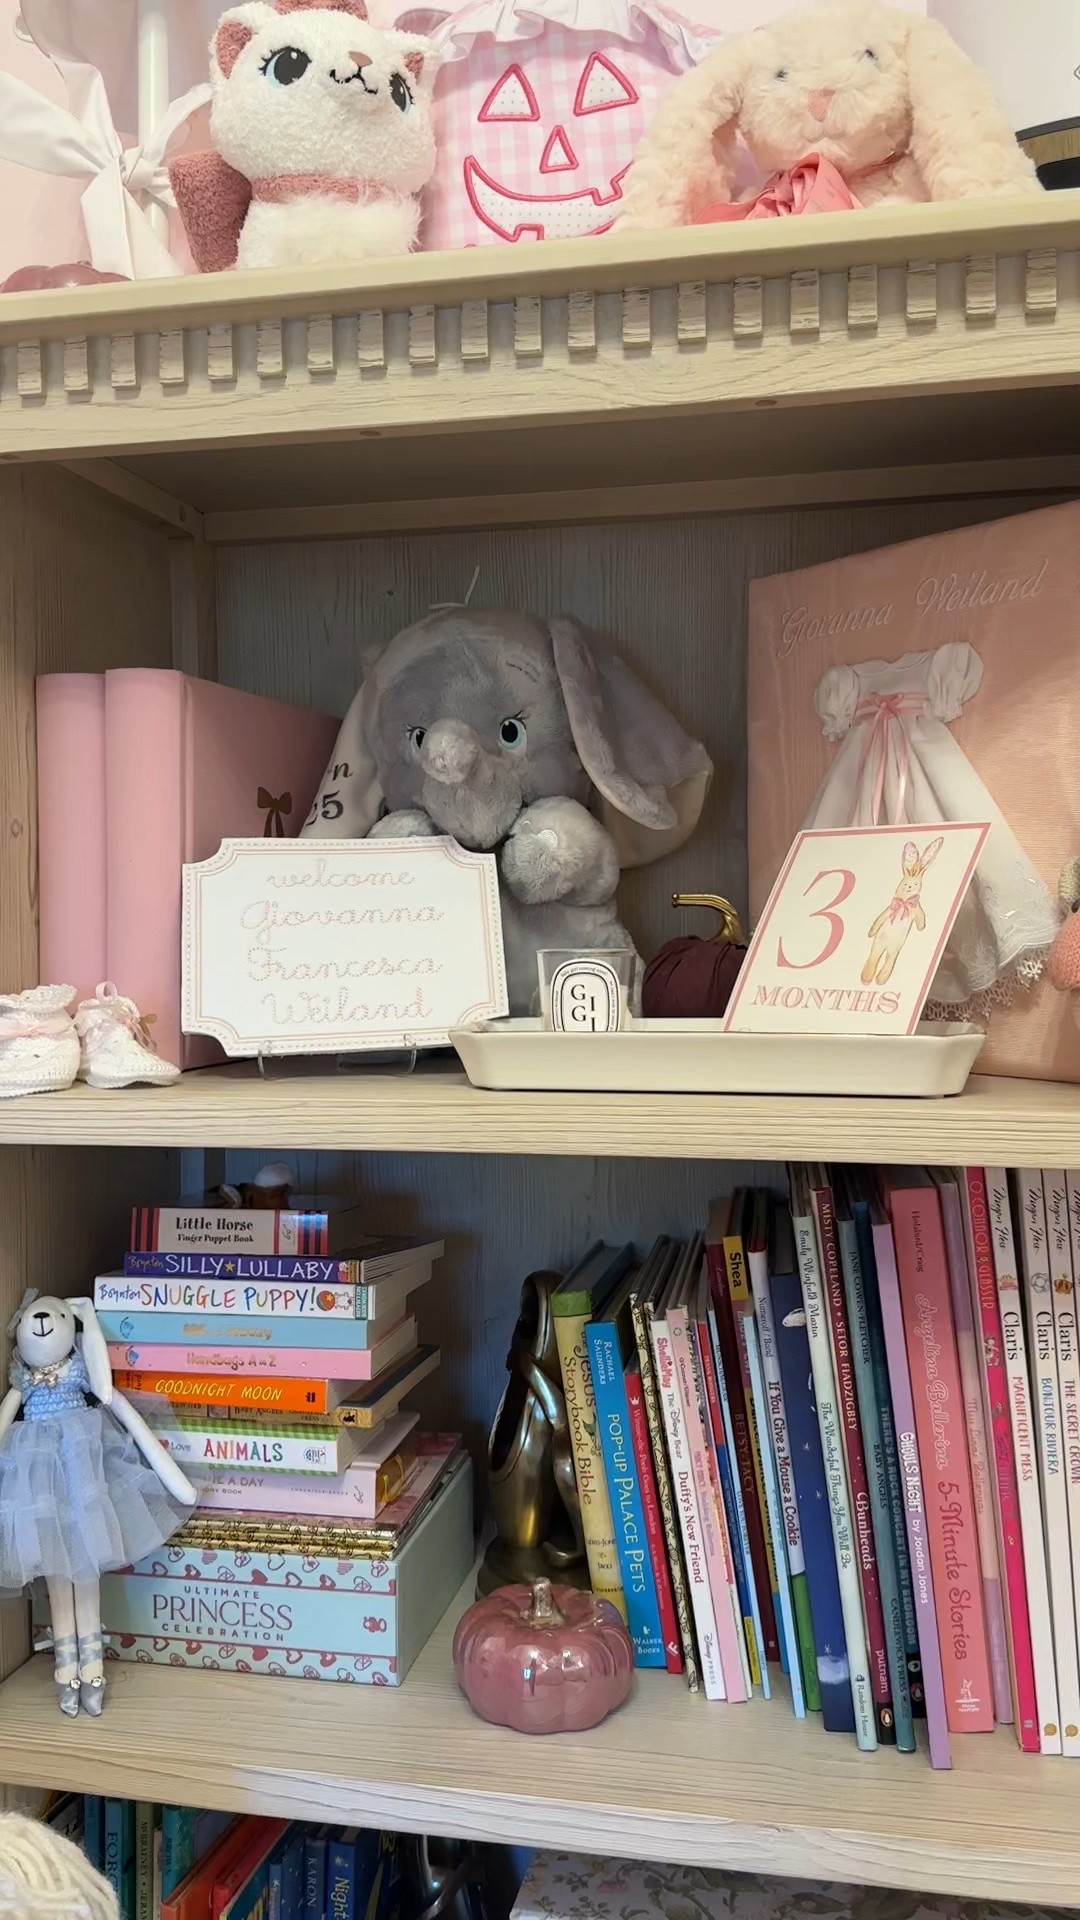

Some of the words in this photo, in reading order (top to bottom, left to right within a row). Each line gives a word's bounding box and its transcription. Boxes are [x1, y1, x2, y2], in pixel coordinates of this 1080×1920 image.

[915, 558, 1049, 617] Weiland
[267, 858, 415, 888] welcome
[240, 900, 444, 945] Giovanna
[776, 869, 857, 969] 3
[248, 947, 443, 982] Francesca
[261, 986, 433, 1024] Weiland
[752, 985, 902, 1015] MONTHS
[822, 1203, 833, 1239] MISTY
[990, 1187, 1008, 1223] Megan
[1025, 1187, 1041, 1225] Megan
[1052, 1187, 1065, 1225] Megan
[175, 1217, 213, 1231] Little
[216, 1217, 254, 1231] Horse
[177, 1234, 203, 1244] Finger
[204, 1235, 232, 1245] Puppet
[233, 1235, 254, 1243] Book
[797, 1229, 809, 1255] Emily
[128, 1255, 164, 1270] Boynton
[165, 1255, 223, 1275] SILLY
[236, 1260, 333, 1281] LULLABY
[728, 1251, 742, 1290] Shea
[801, 1258, 815, 1300] Winfield
[827, 1242, 841, 1306] COPELAND
[850, 1251, 859, 1273] JANE
[99, 1283, 141, 1305] Boynton
[140, 1284, 236, 1308] SNUGGLE
[244, 1286, 316, 1312] PUPPY!
[977, 1265, 992, 1309] GLASSER
[809, 1303, 820, 1337] Martin
[913, 1292, 941, 1380] Angelina
[1003, 1310, 1021, 1360] Claris
[1035, 1310, 1052, 1360] Claris
[1058, 1310, 1076, 1362] Claris
[836, 1321, 847, 1357] SETOR
[187, 1352, 245, 1371] Handbags
[248, 1354, 258, 1367] A
[268, 1355, 277, 1368] Z
[574, 1344, 594, 1407] Jesus
[594, 1339, 607, 1385] SAUNDERS
[603, 1341, 615, 1382] RACHAEL
[657, 1337, 674, 1388] ShellieMay
[155, 1379, 235, 1397] GOODNIGHT
[241, 1386, 283, 1401] MOON
[769, 1380, 778, 1392] If
[770, 1393, 781, 1414] You
[841, 1362, 856, 1431] FIADZIGBEY
[1041, 1377, 1054, 1430] BONJOUR
[1064, 1380, 1076, 1398] THE
[668, 1409, 682, 1438] Disney
[821, 1402, 832, 1420] The
[926, 1378, 952, 1471] Ballerina
[1011, 1376, 1028, 1446] MAGNIFICENT
[1066, 1400, 1080, 1440] SECRET
[564, 1356, 585, 1453] Storybook
[577, 1456, 592, 1505] Bible
[608, 1413, 628, 1473] POP-UP
[674, 1439, 682, 1459] Bear
[773, 1417, 785, 1445] Give
[822, 1421, 837, 1472] Wonderful
[881, 1407, 892, 1454] THERE'S
[171, 1441, 192, 1452] Love
[204, 1438, 283, 1463] ANIMALS
[735, 1413, 754, 1494] BETSY-TACY
[874, 1444, 882, 1468] BABY
[900, 1431, 917, 1474] GHOULS
[1020, 1453, 1032, 1481] MESS
[1044, 1432, 1057, 1476] RIVIERA
[1068, 1440, 1080, 1485] CROWN
[228, 1476, 238, 1486] A
[240, 1477, 264, 1488] DAY
[677, 1471, 692, 1512] Duffy's
[778, 1455, 792, 1494] Mouse
[828, 1473, 841, 1505] Things
[876, 1471, 887, 1508] ANGELS
[888, 1466, 897, 1496] ROCK
[614, 1476, 639, 1544] PALACE
[783, 1495, 790, 1503] a
[832, 1506, 844, 1526] You
[685, 1514, 696, 1540] New
[784, 1505, 799, 1545] Cookie
[837, 1526, 848, 1551] Will
[854, 1491, 873, 1570] Bunheads
[892, 1499, 903, 1551] CONCERT
[910, 1518, 921, 1533] by
[937, 1480, 967, 1581] 5-Minute
[624, 1550, 646, 1593] PETS
[689, 1543, 703, 1583] Friend
[840, 1553, 850, 1569] Be
[913, 1535, 926, 1571] Jordan
[184, 1585, 260, 1599] ULTIMATE
[900, 1569, 908, 1585] MY
[918, 1573, 929, 1604] Jones
[152, 1594, 293, 1631] PRINCESS
[890, 1598, 903, 1661] CANDLEWICK
[902, 1589, 914, 1644] BEDROOM
[949, 1585, 973, 1661] Stories
[162, 1622, 284, 1641] CELEBRATION
[632, 1637, 662, 1645] WALKER
[638, 1646, 660, 1654] BOOKS
[703, 1633, 713, 1658] Disney
[707, 1660, 715, 1684] PRESS
[874, 1649, 887, 1693] putnam
[856, 1684, 867, 1714] Random
[860, 1715, 869, 1737] House
[307, 1856, 318, 1908] KARON
[330, 1876, 350, 1920] Night
